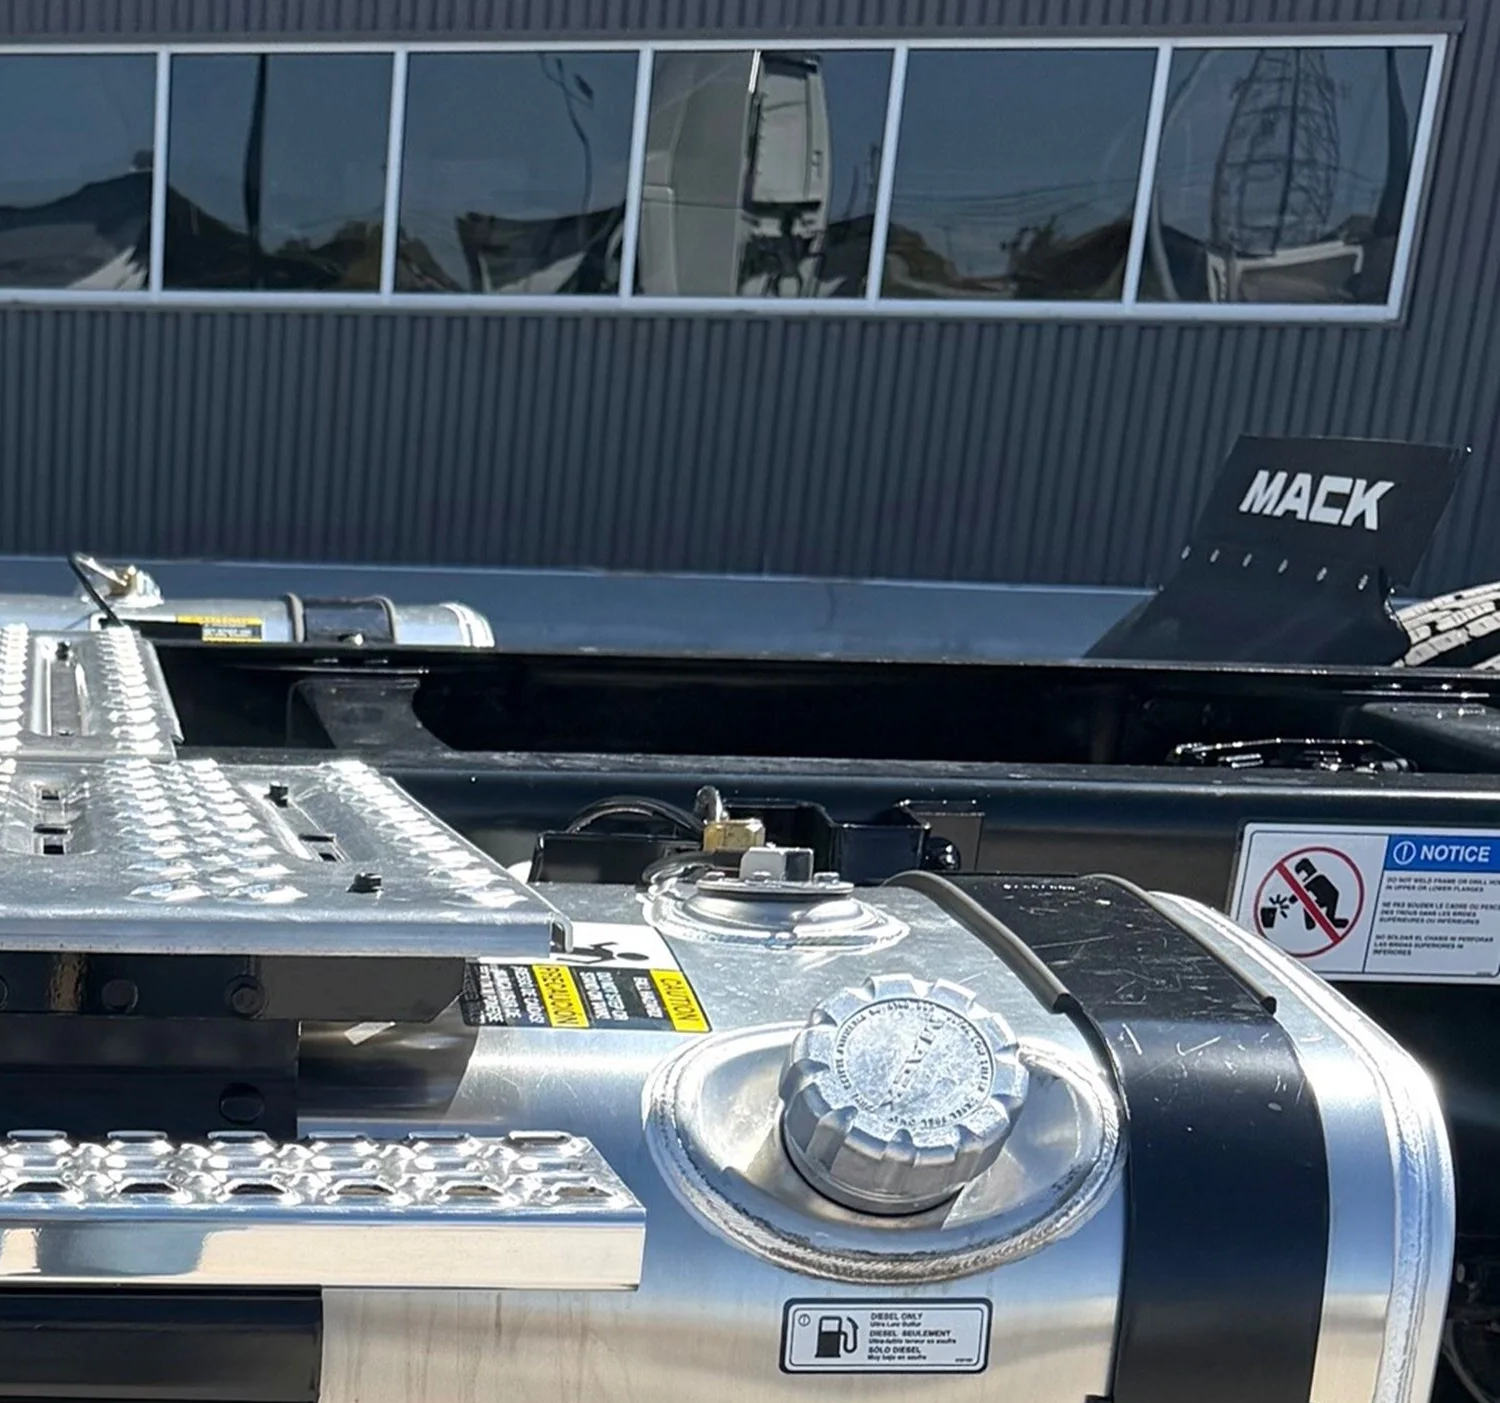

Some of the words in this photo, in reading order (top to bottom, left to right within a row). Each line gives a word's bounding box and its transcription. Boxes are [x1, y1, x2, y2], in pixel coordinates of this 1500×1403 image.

[1239, 470, 1395, 530] MACK
[1420, 845, 1491, 863] NOTICE
[538, 965, 581, 1025] PRECAUCIÓN
[660, 977, 700, 1023] CAUTION
